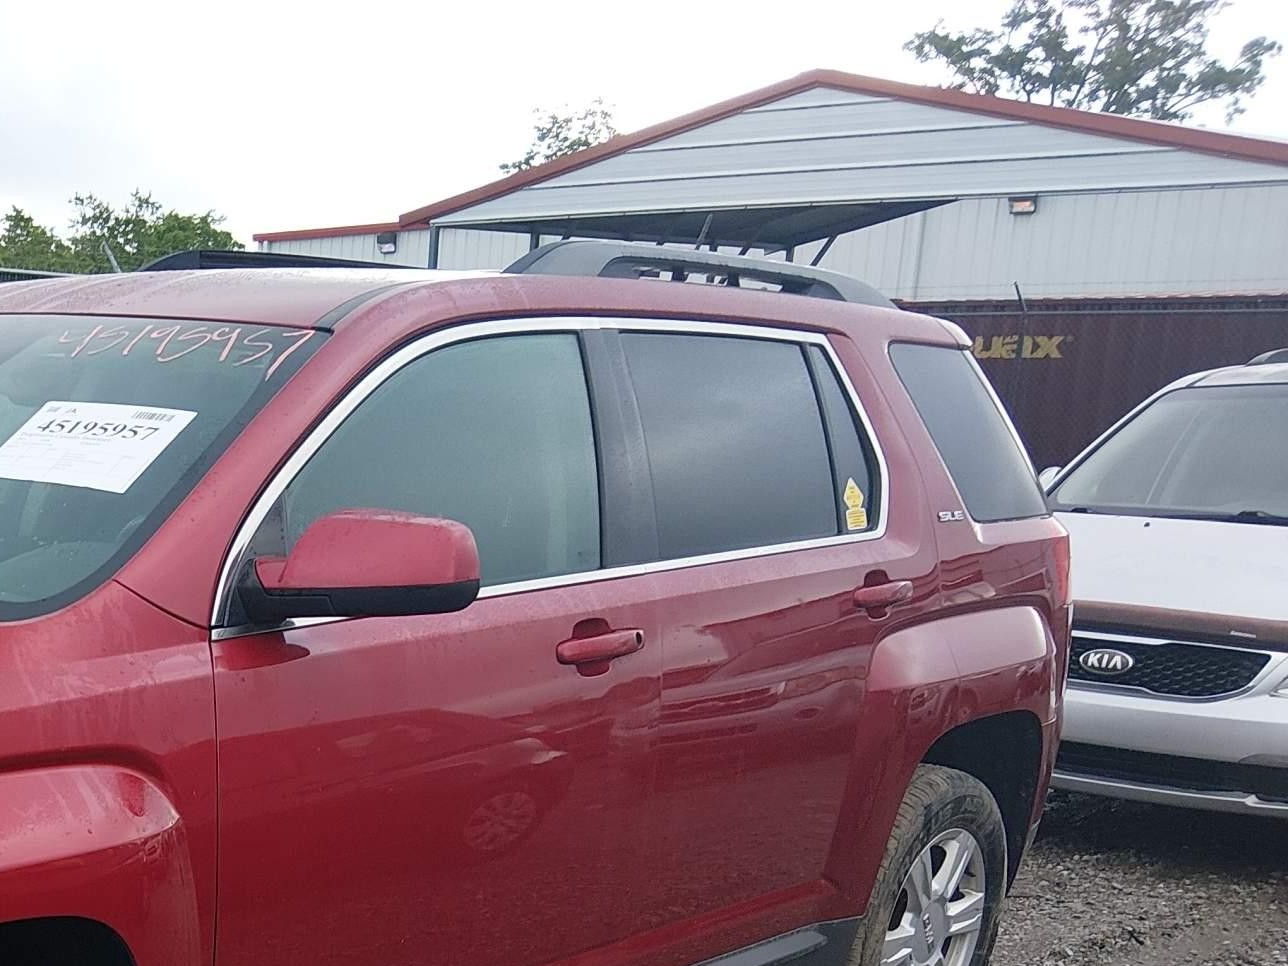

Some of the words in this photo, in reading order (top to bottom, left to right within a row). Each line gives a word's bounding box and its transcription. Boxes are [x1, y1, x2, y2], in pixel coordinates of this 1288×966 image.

[59, 324, 315, 382] 45195957
[37, 419, 159, 440] 45195957
[938, 510, 964, 522] SLE
[1086, 652, 1123, 670] KIA
